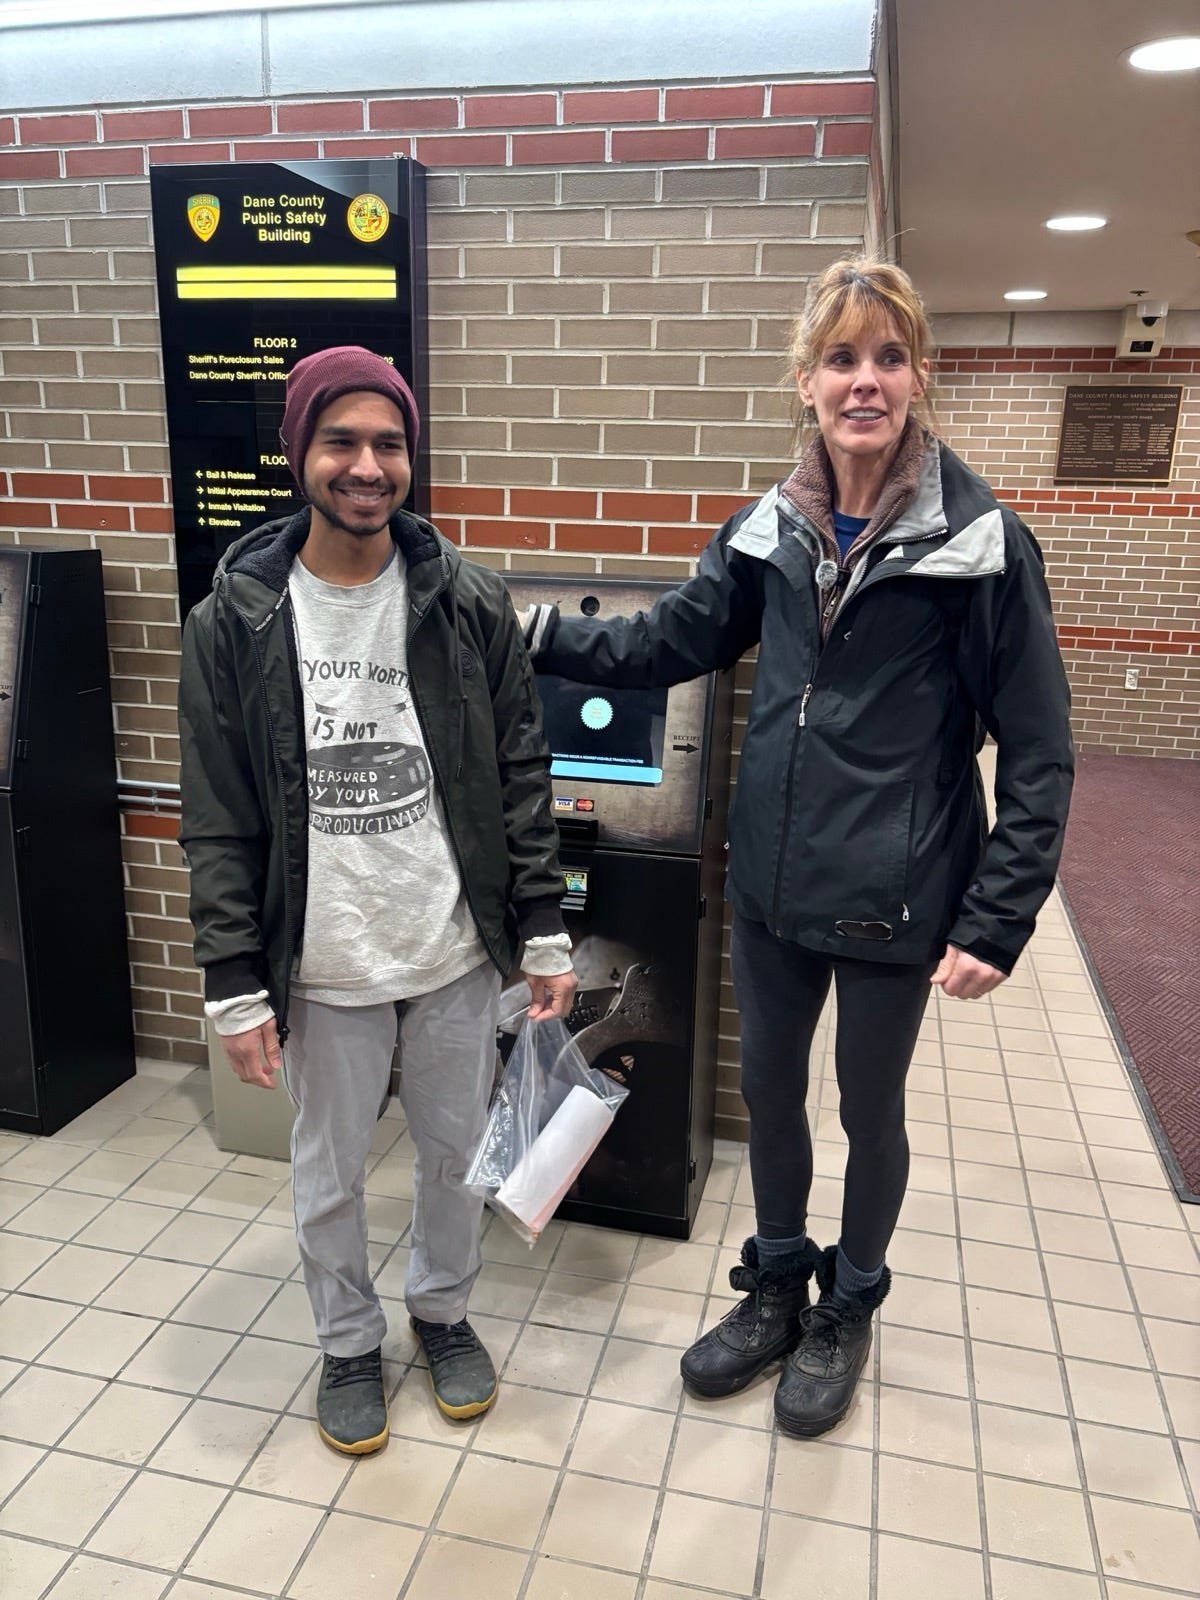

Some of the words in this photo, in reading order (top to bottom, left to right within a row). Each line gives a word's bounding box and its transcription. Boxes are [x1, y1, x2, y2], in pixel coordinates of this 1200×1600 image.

[243, 195, 275, 207] Dane
[279, 194, 324, 209] County
[242, 212, 282, 224] Public
[286, 211, 326, 226] Safety
[258, 228, 311, 244] Building
[253, 338, 288, 348] FLOOR
[290, 338, 297, 348] 2
[188, 355, 218, 364] Sheriff's
[219, 355, 262, 364] Foreclosure
[263, 355, 284, 364] Sales
[189, 371, 208, 379] Dane
[208, 371, 235, 381] County
[236, 371, 266, 380] Sheriff's
[268, 371, 289, 380] Offic
[260, 455, 290, 465] FLOO
[206, 470, 220, 479] Bail
[220, 471, 227, 479] &
[227, 471, 256, 480] Release
[207, 487, 226, 495] Initial
[227, 487, 270, 497] Appearance
[270, 488, 292, 497] Court
[208, 502, 232, 511] Inmate
[232, 503, 266, 512] Visitation
[208, 517, 241, 527] Elevators
[302, 659, 362, 682] YOUR
[312, 716, 335, 740] IS
[342, 721, 378, 741] NOT
[307, 767, 378, 783] MEASURED
[335, 787, 380, 804] YOUR
[310, 798, 429, 834] PRODUCTIVITY
